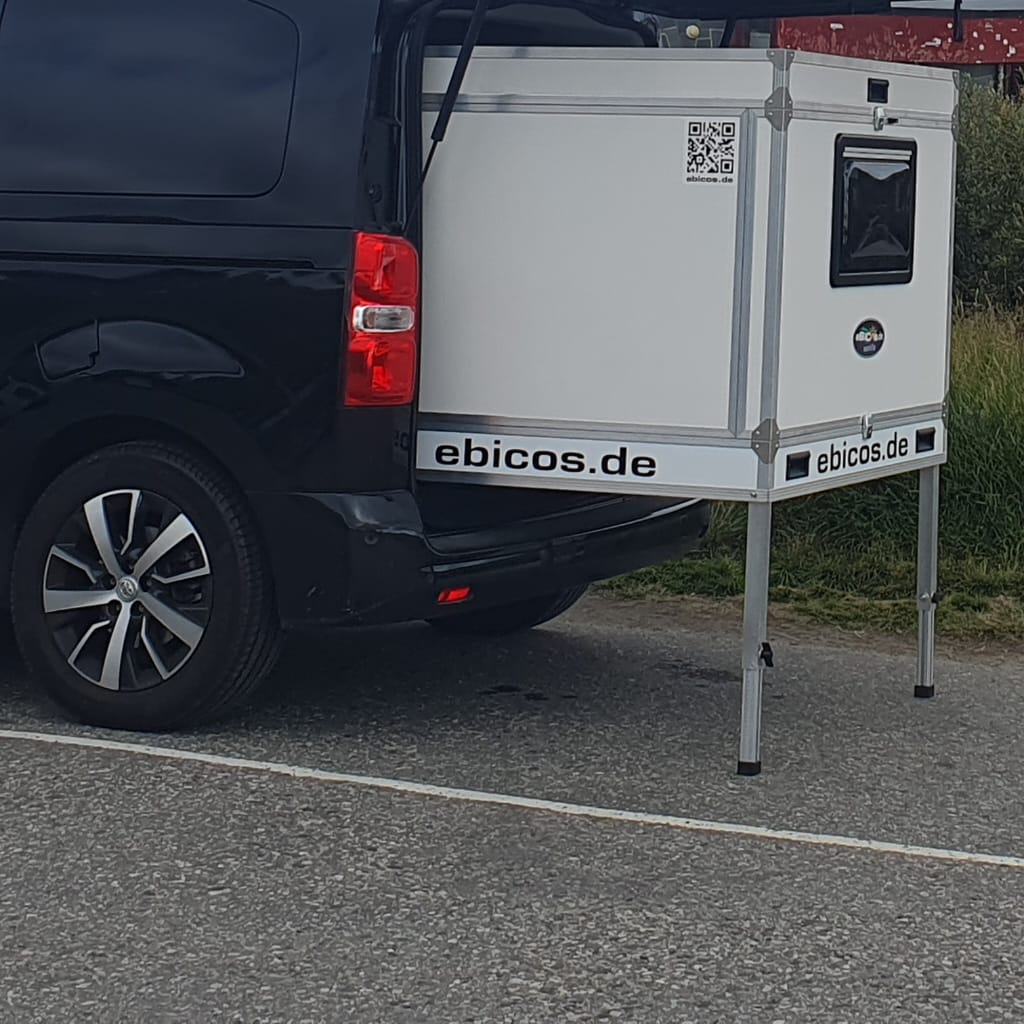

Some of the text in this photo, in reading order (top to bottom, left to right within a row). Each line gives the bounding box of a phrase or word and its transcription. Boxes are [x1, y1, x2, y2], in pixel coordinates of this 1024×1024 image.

[685, 175, 734, 184] ebicos.de
[434, 437, 657, 478] ebicos.de
[816, 431, 909, 474] ebicos.de
